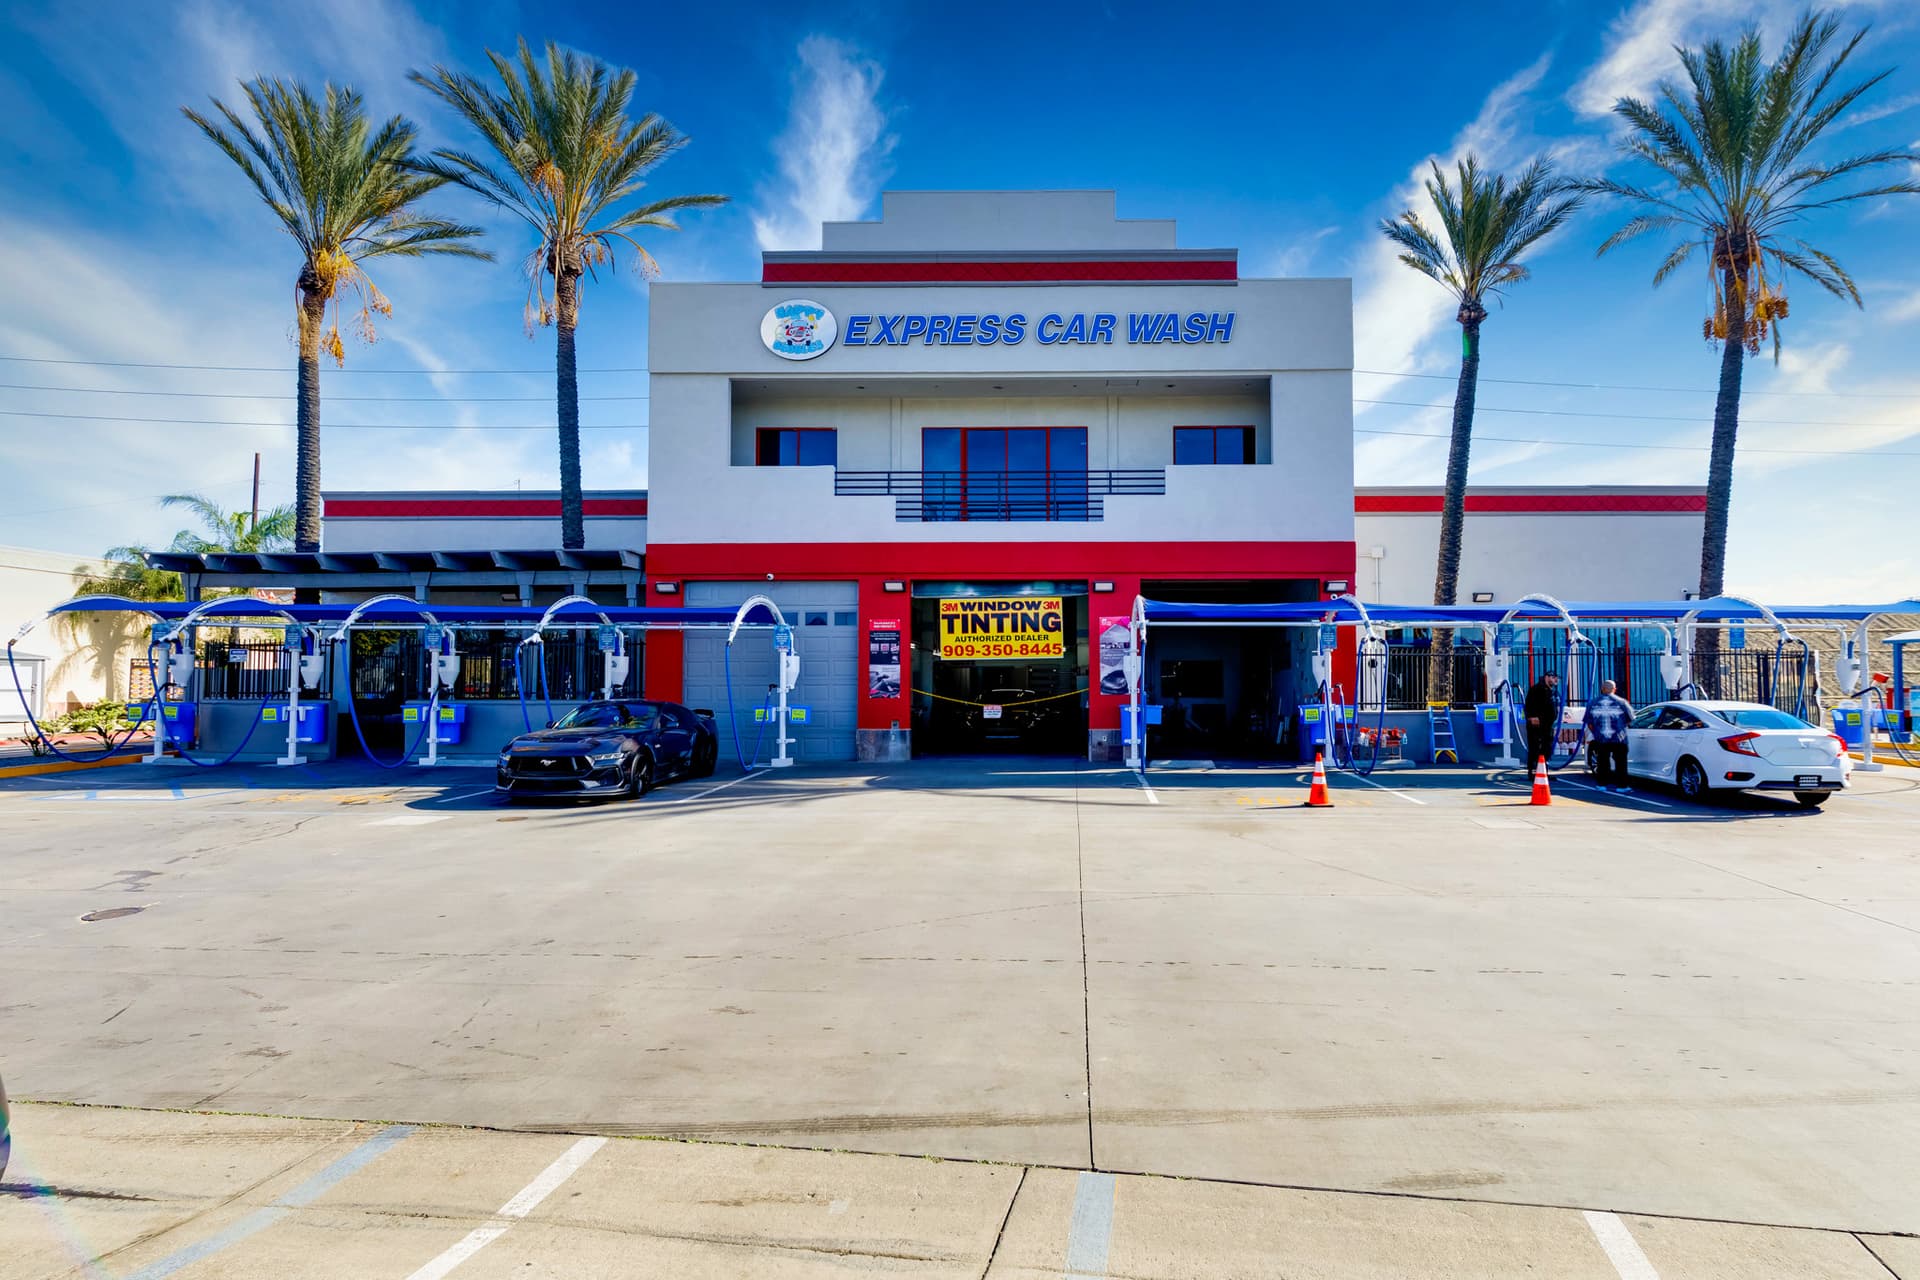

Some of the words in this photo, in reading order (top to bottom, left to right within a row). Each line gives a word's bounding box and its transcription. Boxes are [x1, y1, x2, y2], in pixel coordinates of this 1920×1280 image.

[843, 313, 1027, 345] EXPRESS
[1037, 313, 1118, 345] CAR
[1127, 312, 1237, 345] WASH
[942, 603, 958, 612] 3M
[960, 601, 1042, 611] WINDOW
[1043, 601, 1060, 610] 3M
[941, 612, 1062, 634] TINTING
[955, 635, 1012, 643] AUTHORIZED
[943, 643, 1063, 656] 909-350-8445
